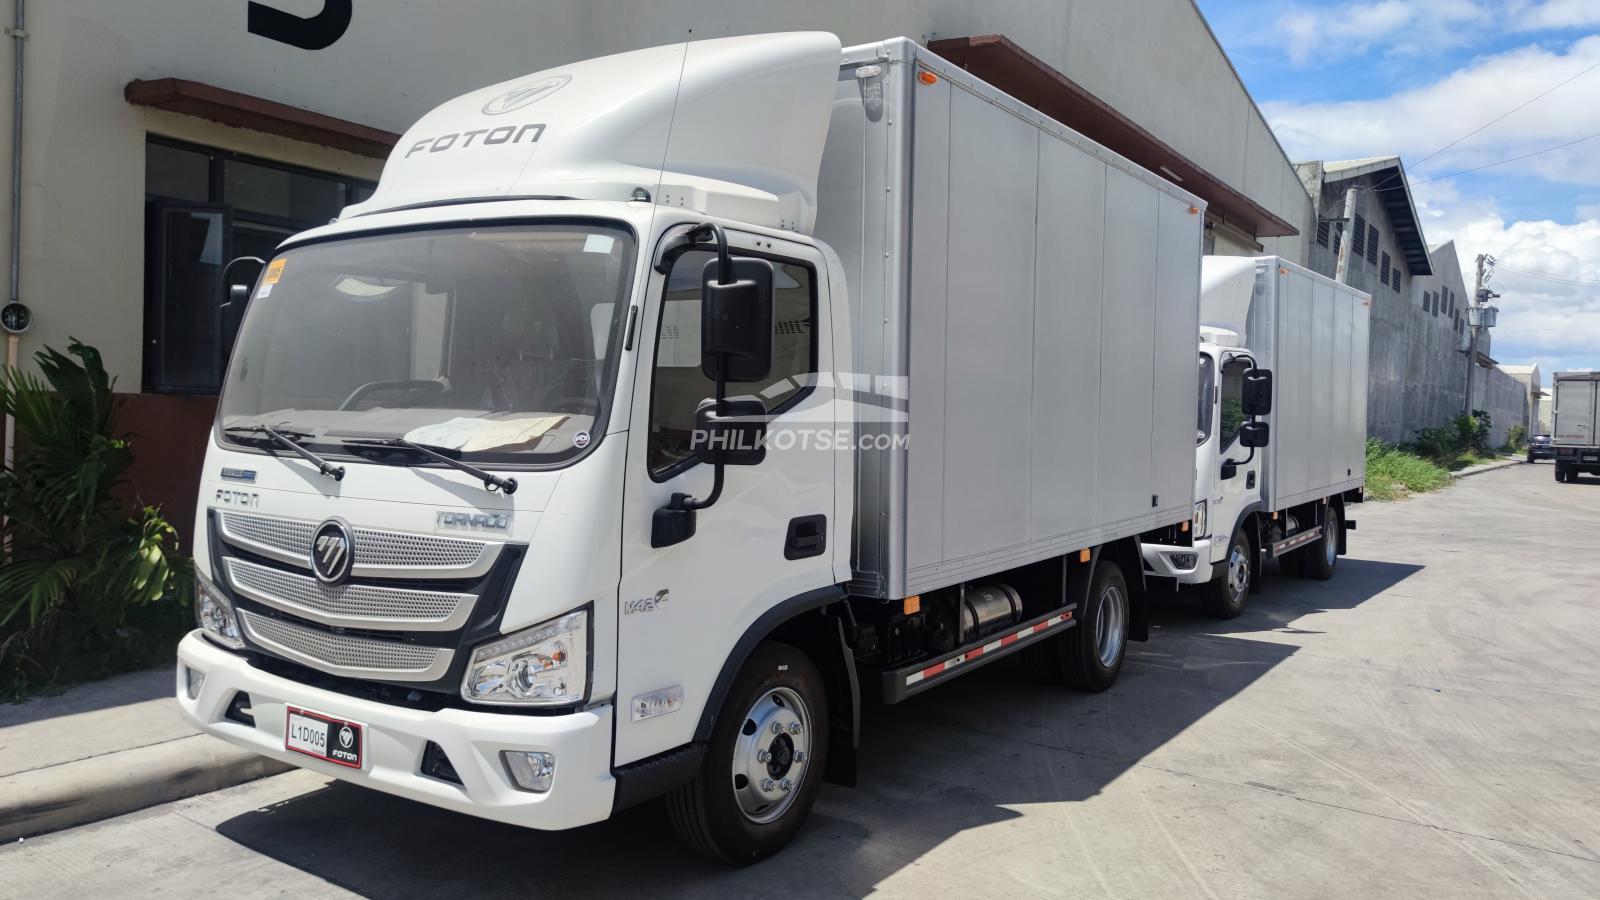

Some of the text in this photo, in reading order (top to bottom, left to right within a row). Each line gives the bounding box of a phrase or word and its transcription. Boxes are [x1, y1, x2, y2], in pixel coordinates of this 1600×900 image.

[404, 123, 547, 159] FOTON
[216, 489, 259, 508] FOTON
[436, 511, 512, 530] TORNADO
[291, 723, 325, 747] L1D005
[332, 749, 358, 761] FOTON
